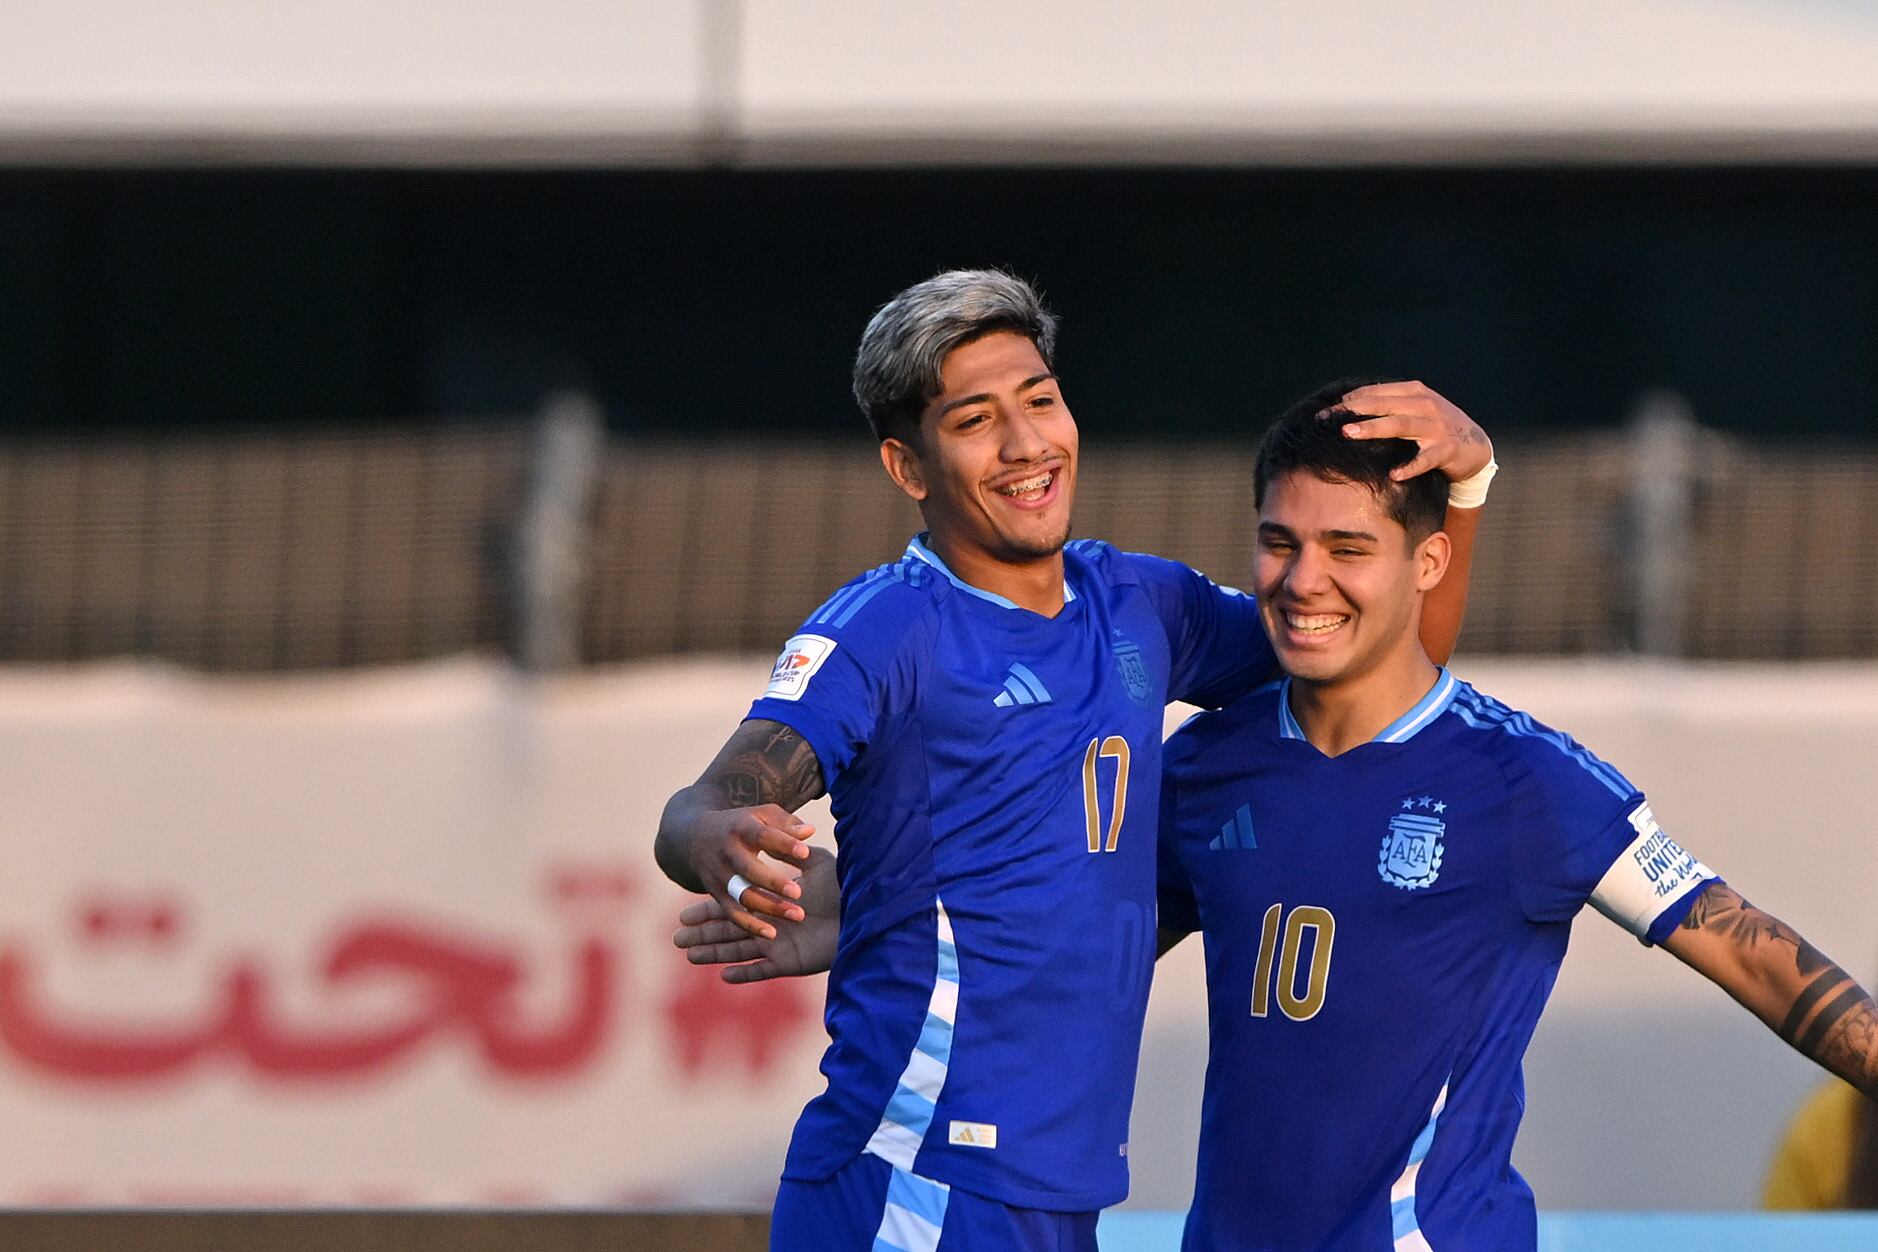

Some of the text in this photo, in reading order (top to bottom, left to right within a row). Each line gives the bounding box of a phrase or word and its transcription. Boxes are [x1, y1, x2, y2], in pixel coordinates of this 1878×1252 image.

[1082, 735, 1131, 852] 17
[1391, 832, 1428, 868] AFA
[1654, 879, 1679, 898] the
[1250, 902, 1336, 1022] 10
